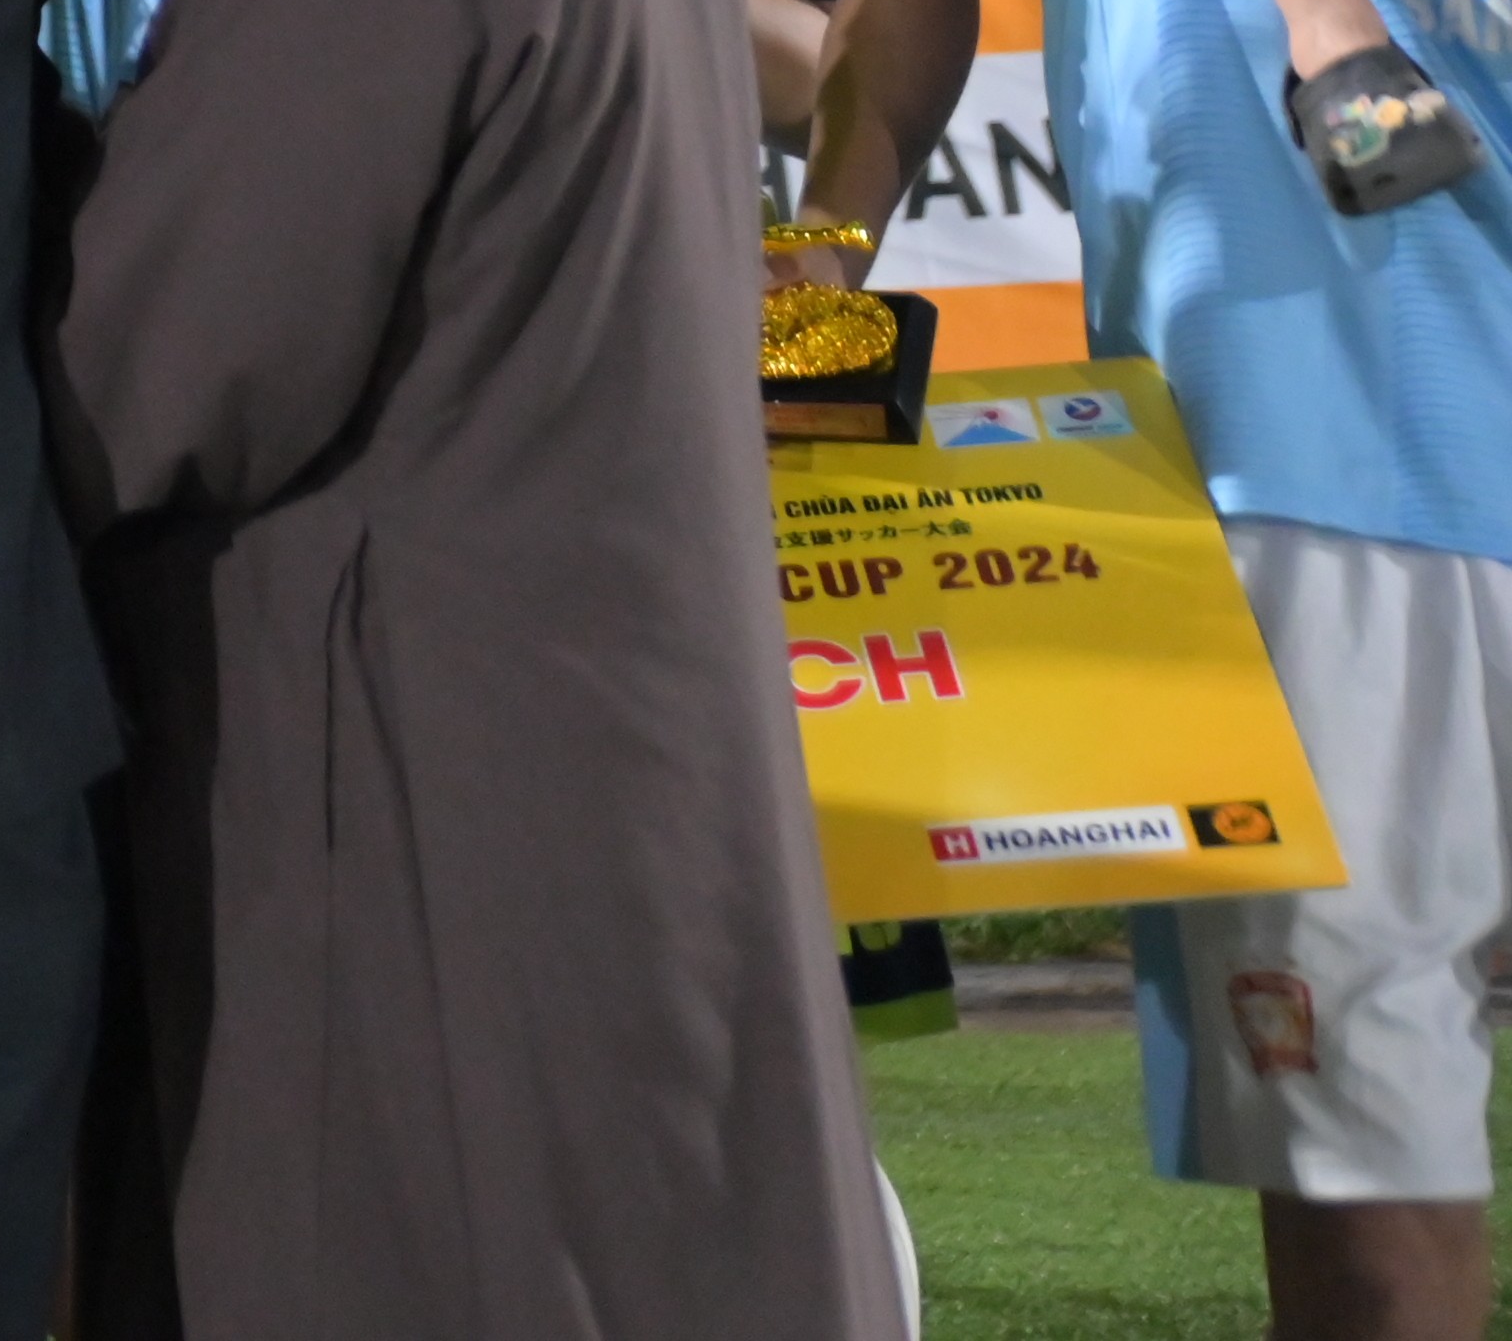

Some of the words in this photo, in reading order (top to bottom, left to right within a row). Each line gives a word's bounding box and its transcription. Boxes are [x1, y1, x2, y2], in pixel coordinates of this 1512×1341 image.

[783, 493, 857, 520] CHÙA
[863, 491, 908, 516] ĐẠI
[917, 485, 955, 510] ÂN
[962, 482, 1045, 505] TOKYO
[777, 555, 904, 604] CUP
[932, 542, 1101, 591] 2024
[984, 818, 1172, 853] HOANGHAI
